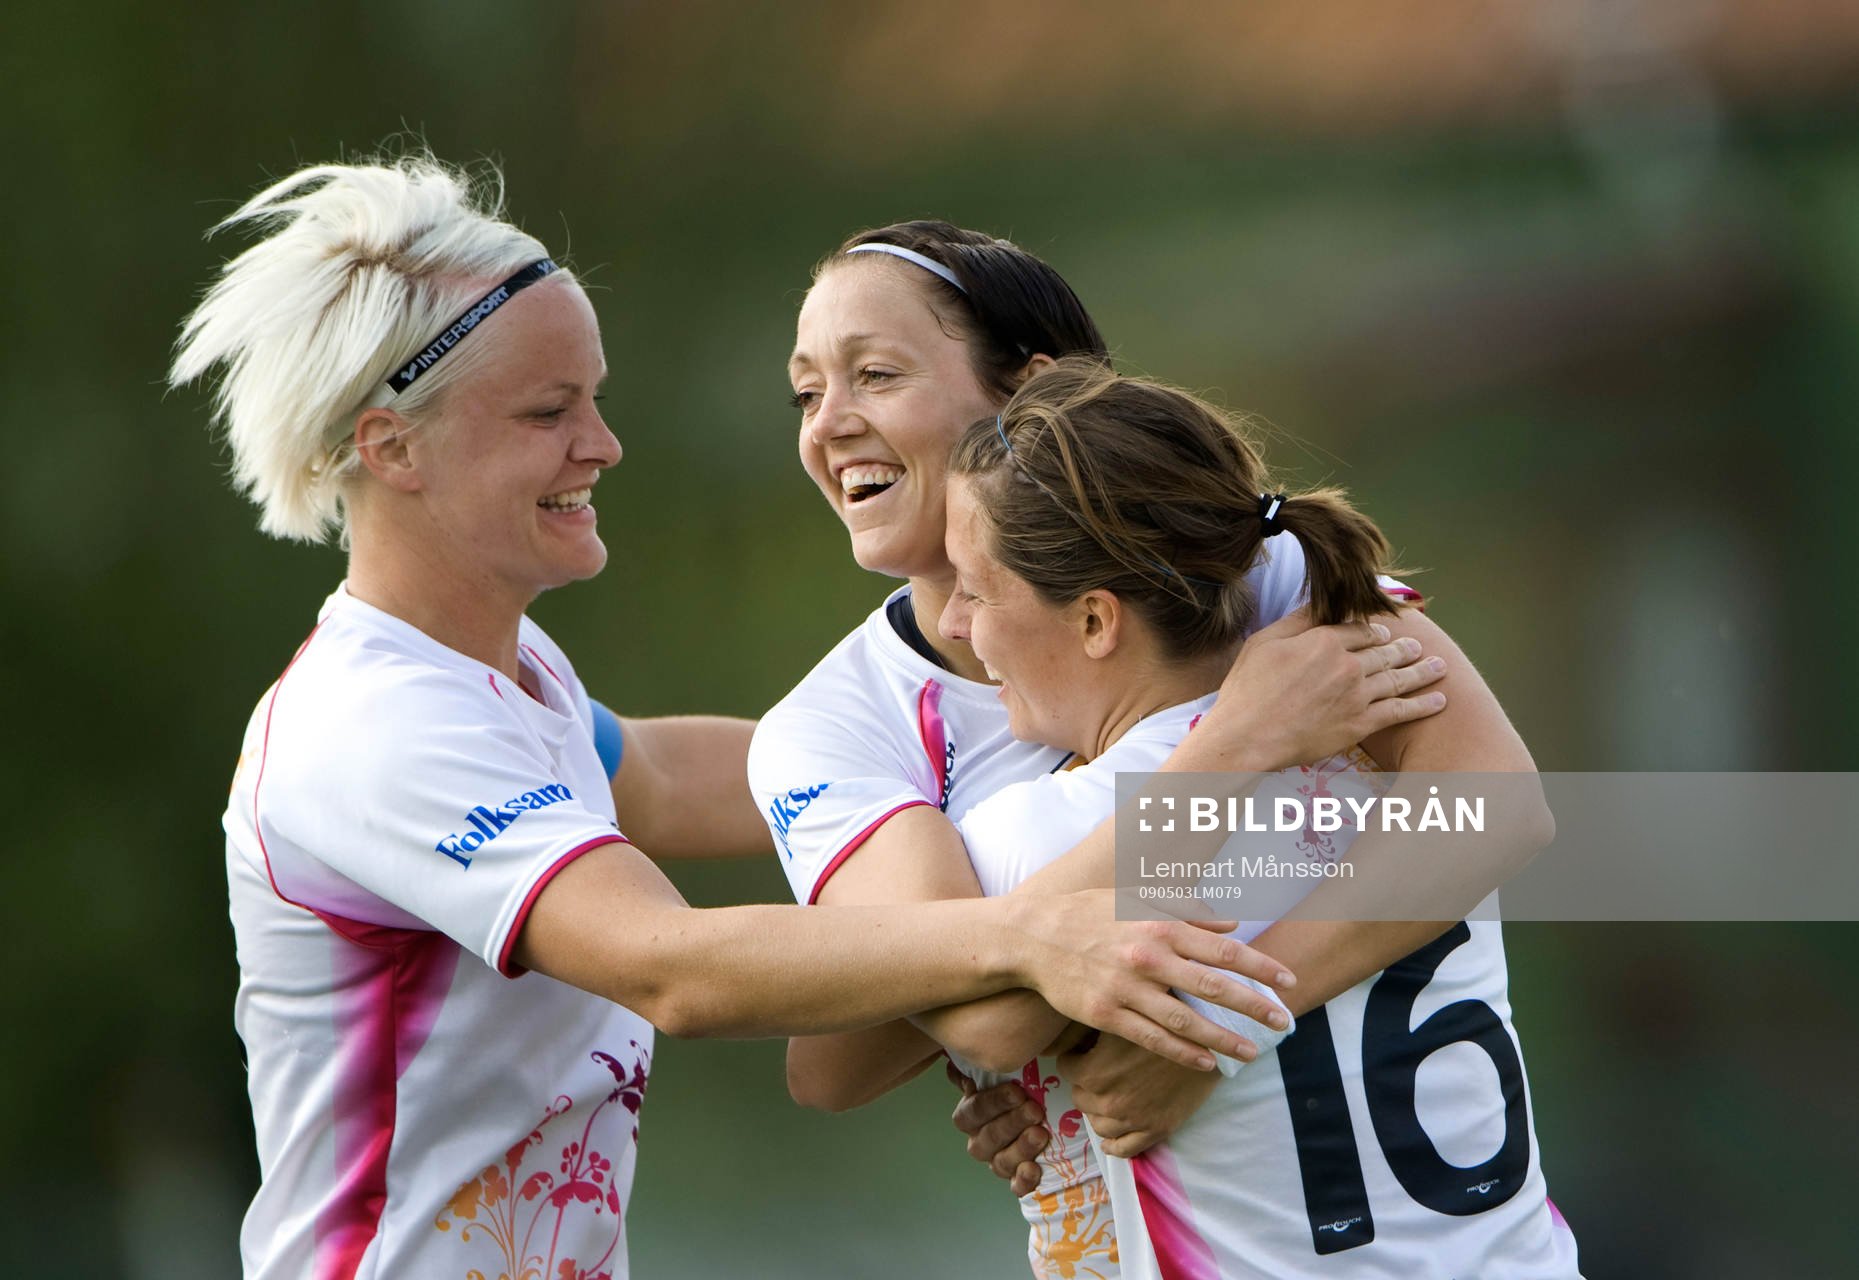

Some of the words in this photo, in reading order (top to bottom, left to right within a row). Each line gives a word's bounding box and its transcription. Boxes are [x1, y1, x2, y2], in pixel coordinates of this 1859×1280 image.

[418, 286, 510, 369] INTERSPORT
[435, 783, 575, 872] Folksam
[1276, 919, 1530, 1255] 16
